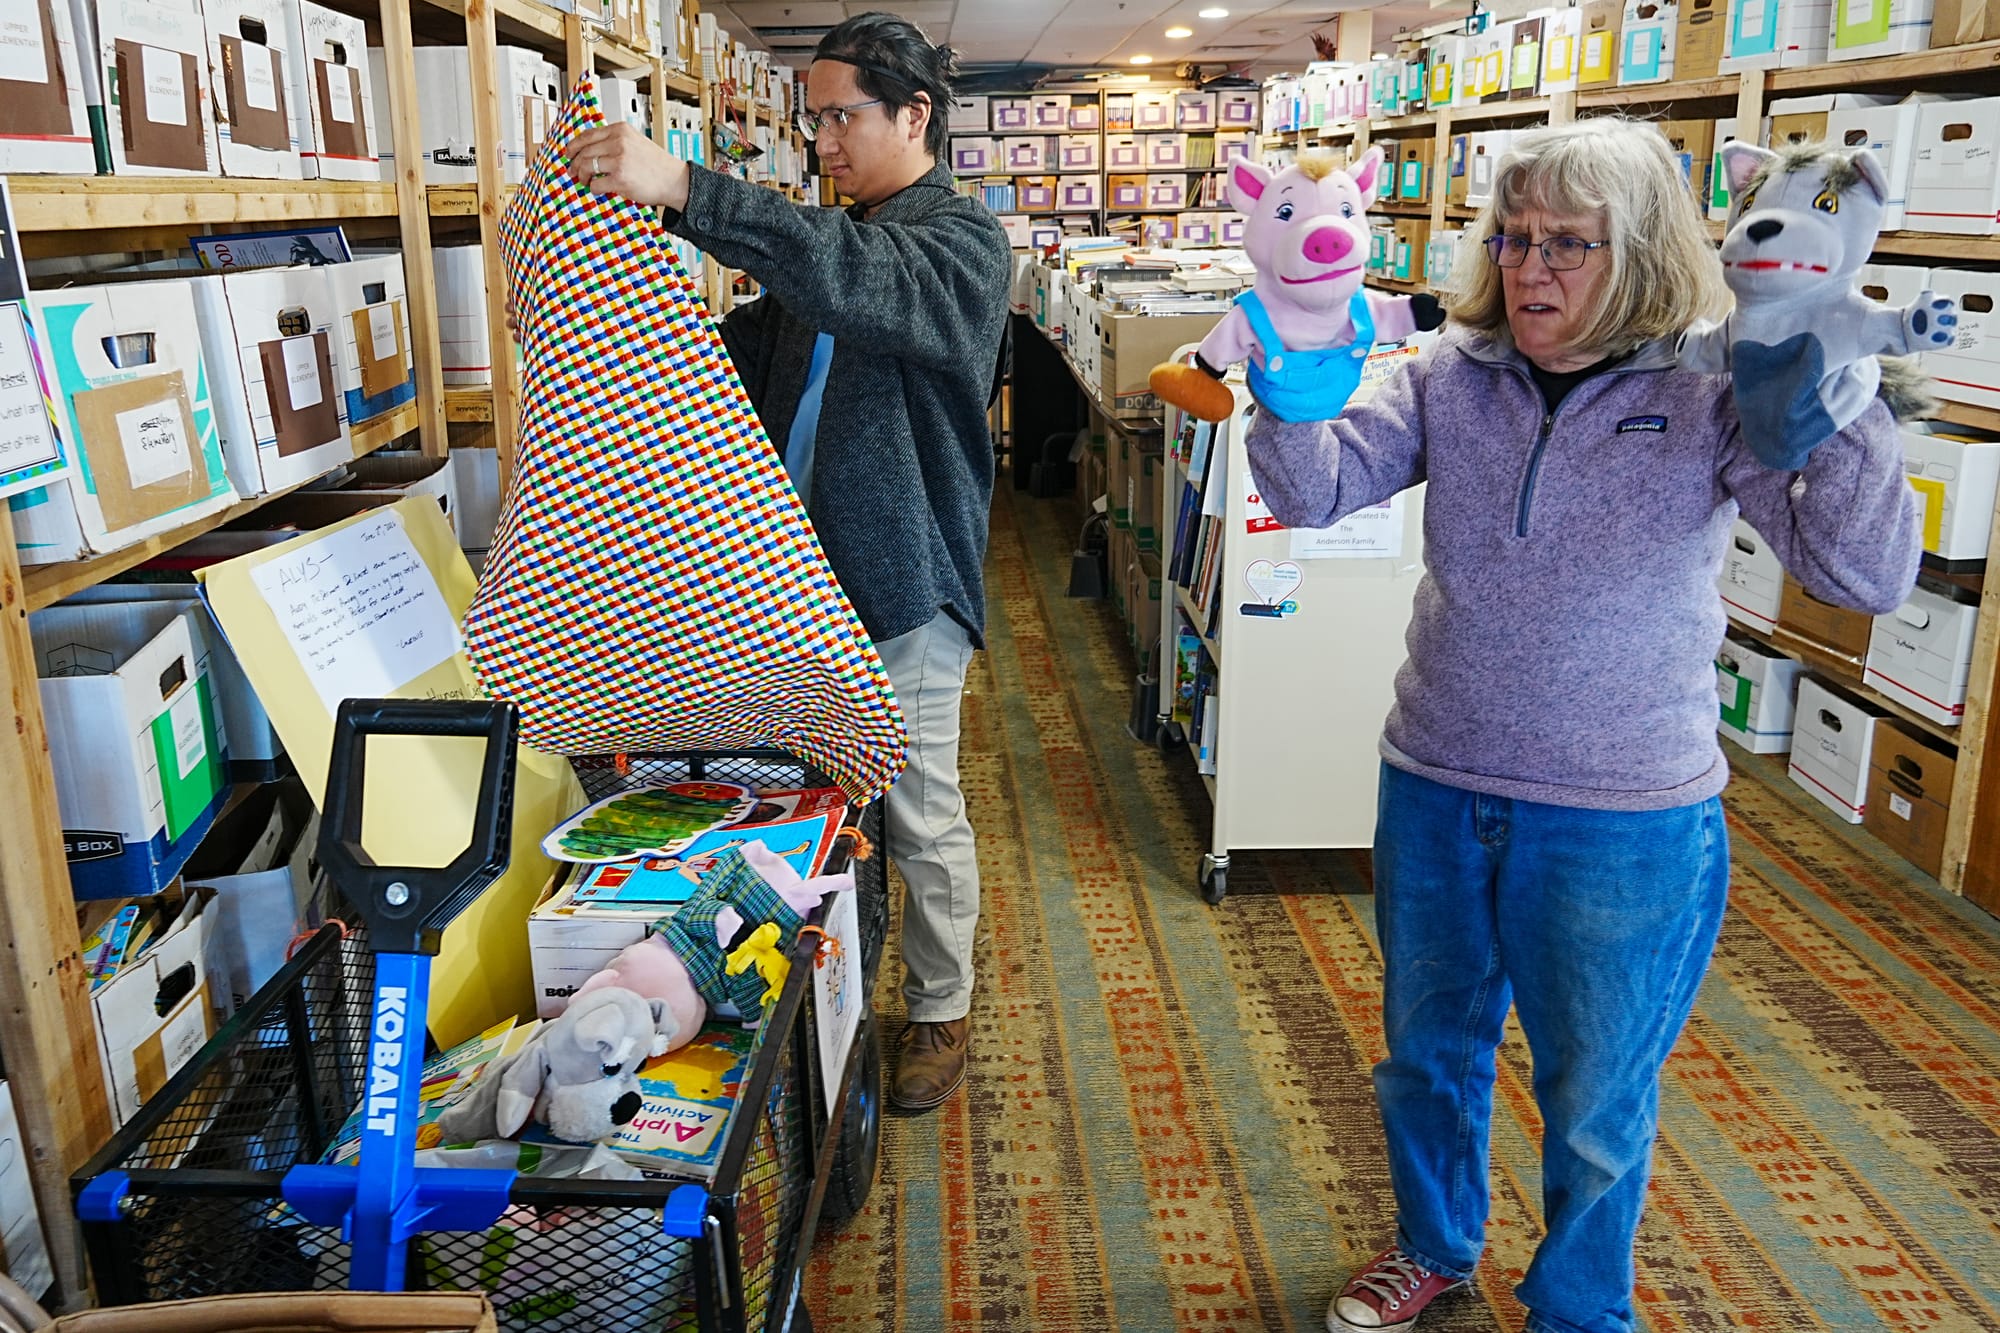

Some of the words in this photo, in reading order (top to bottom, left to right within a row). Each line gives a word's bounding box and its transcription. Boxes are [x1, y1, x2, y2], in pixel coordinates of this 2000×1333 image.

[5, 22, 30, 33] UPPER
[156, 76, 174, 84] UPPER
[149, 86, 182, 97] ELEMENTARY
[295, 362, 310, 373] UPPER
[290, 370, 317, 385] ELEMENTARY
[1380, 512, 1390, 521] By
[1340, 524, 1354, 533] The
[1316, 537, 1350, 546] Anderson
[1351, 538, 1377, 547] Family
[78, 840, 115, 853] BOX
[367, 986, 408, 1136] KOBALT
[629, 1117, 705, 1144] Alph
[612, 1131, 641, 1144] The
